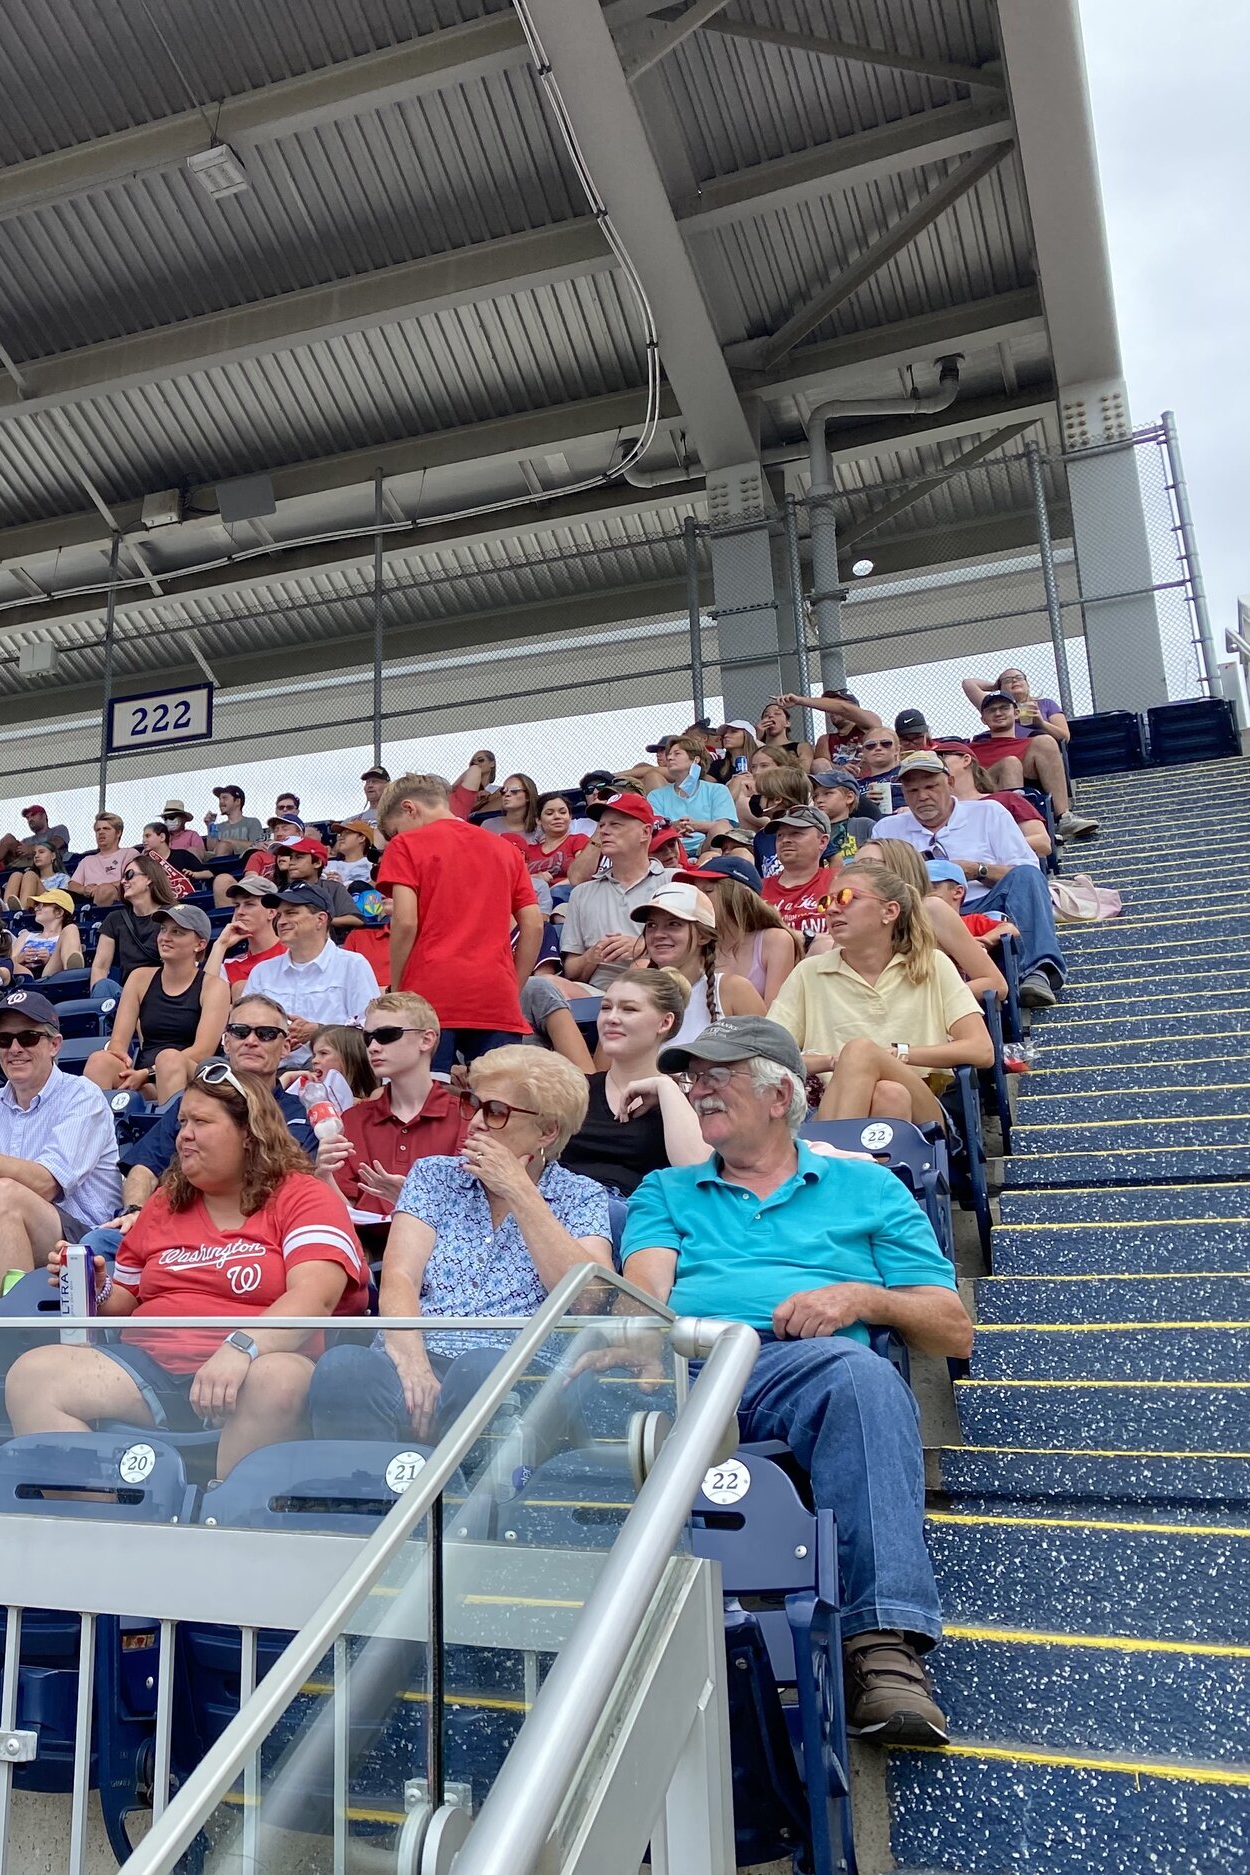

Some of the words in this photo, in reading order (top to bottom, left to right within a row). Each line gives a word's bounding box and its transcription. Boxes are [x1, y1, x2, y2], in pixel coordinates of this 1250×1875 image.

[130, 700, 191, 736] 222
[6, 990, 28, 1005] W
[868, 1130, 886, 1142] 22
[158, 1238, 267, 1272] Washington
[226, 1263, 262, 1295] W
[60, 1272, 71, 1315] LTRA
[127, 1455, 148, 1471] 20
[394, 1464, 416, 1480] 21
[712, 1472, 739, 1490] 22
